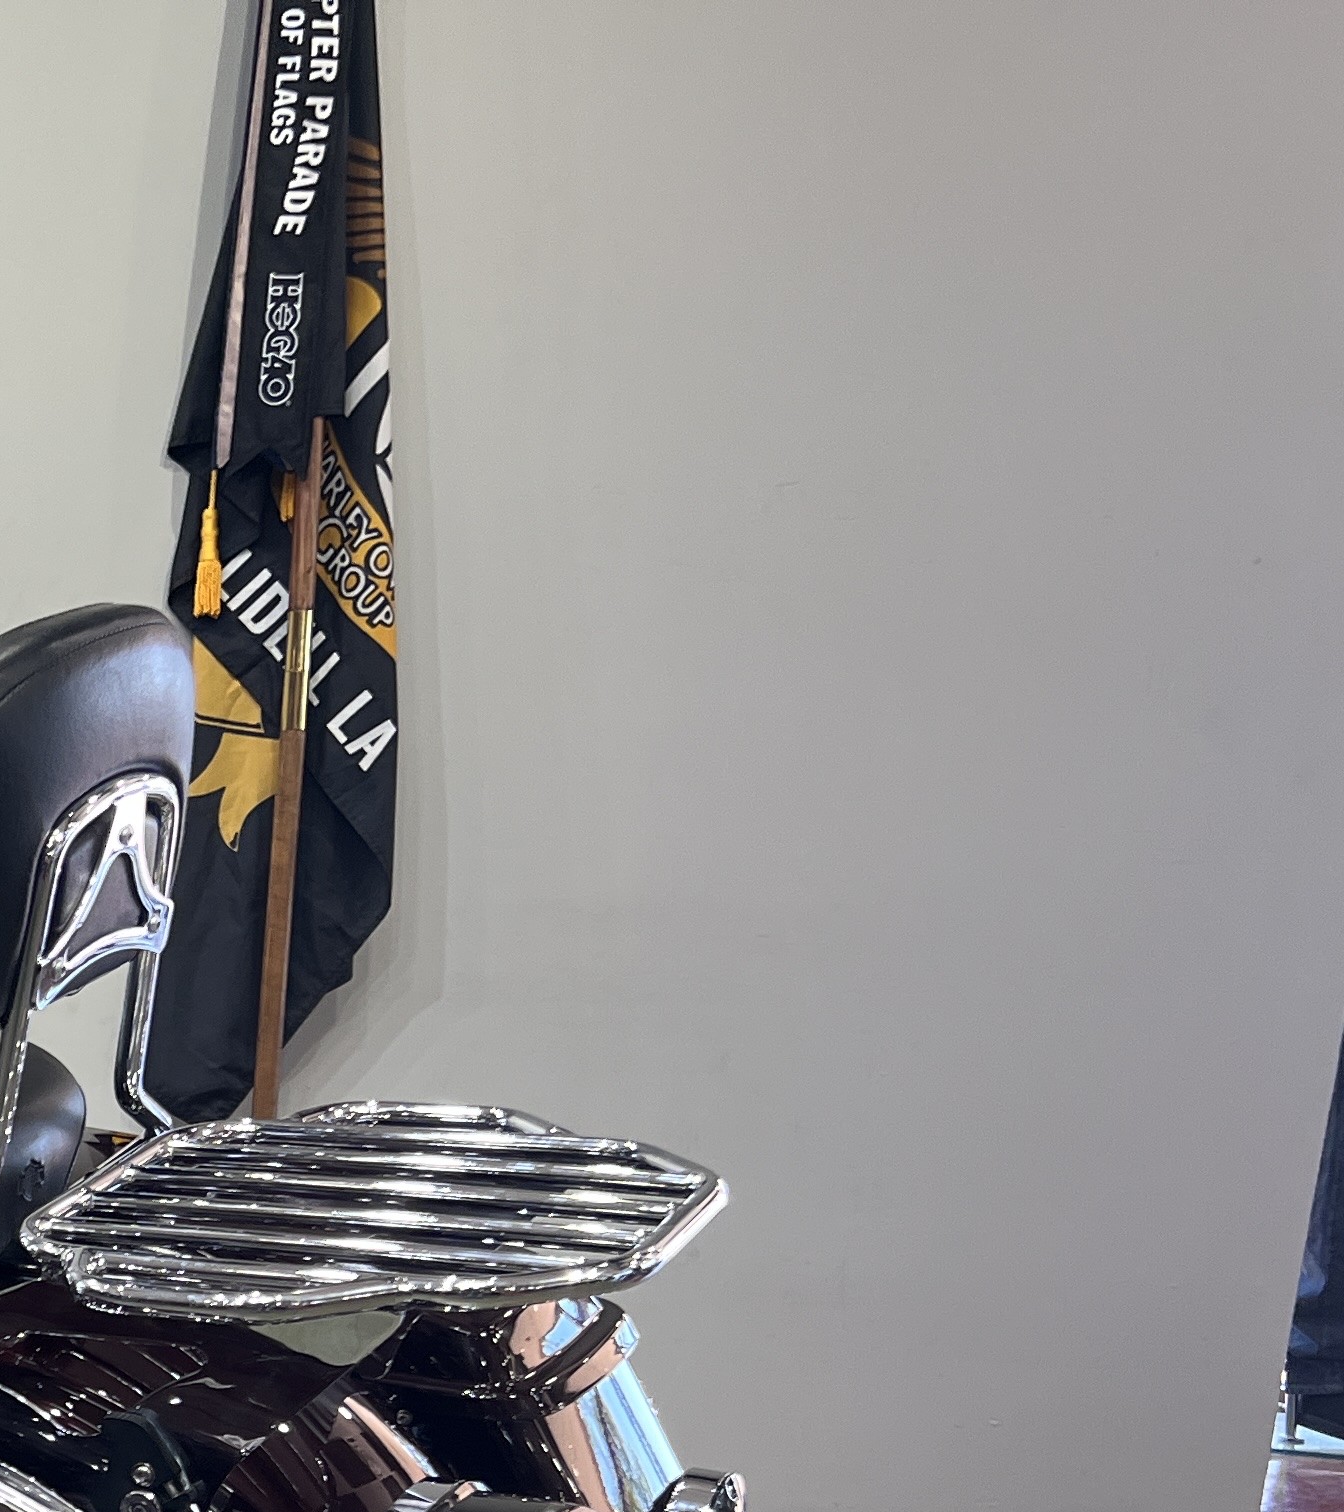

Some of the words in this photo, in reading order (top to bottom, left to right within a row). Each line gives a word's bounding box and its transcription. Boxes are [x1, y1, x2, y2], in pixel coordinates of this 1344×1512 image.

[280, 7, 306, 46] OF
[269, 54, 302, 146] FLAGS
[273, 95, 335, 237] PARADE
[321, 442, 379, 548] ARLEY
[316, 518, 395, 626] GROUP
[326, 690, 397, 772] LA
